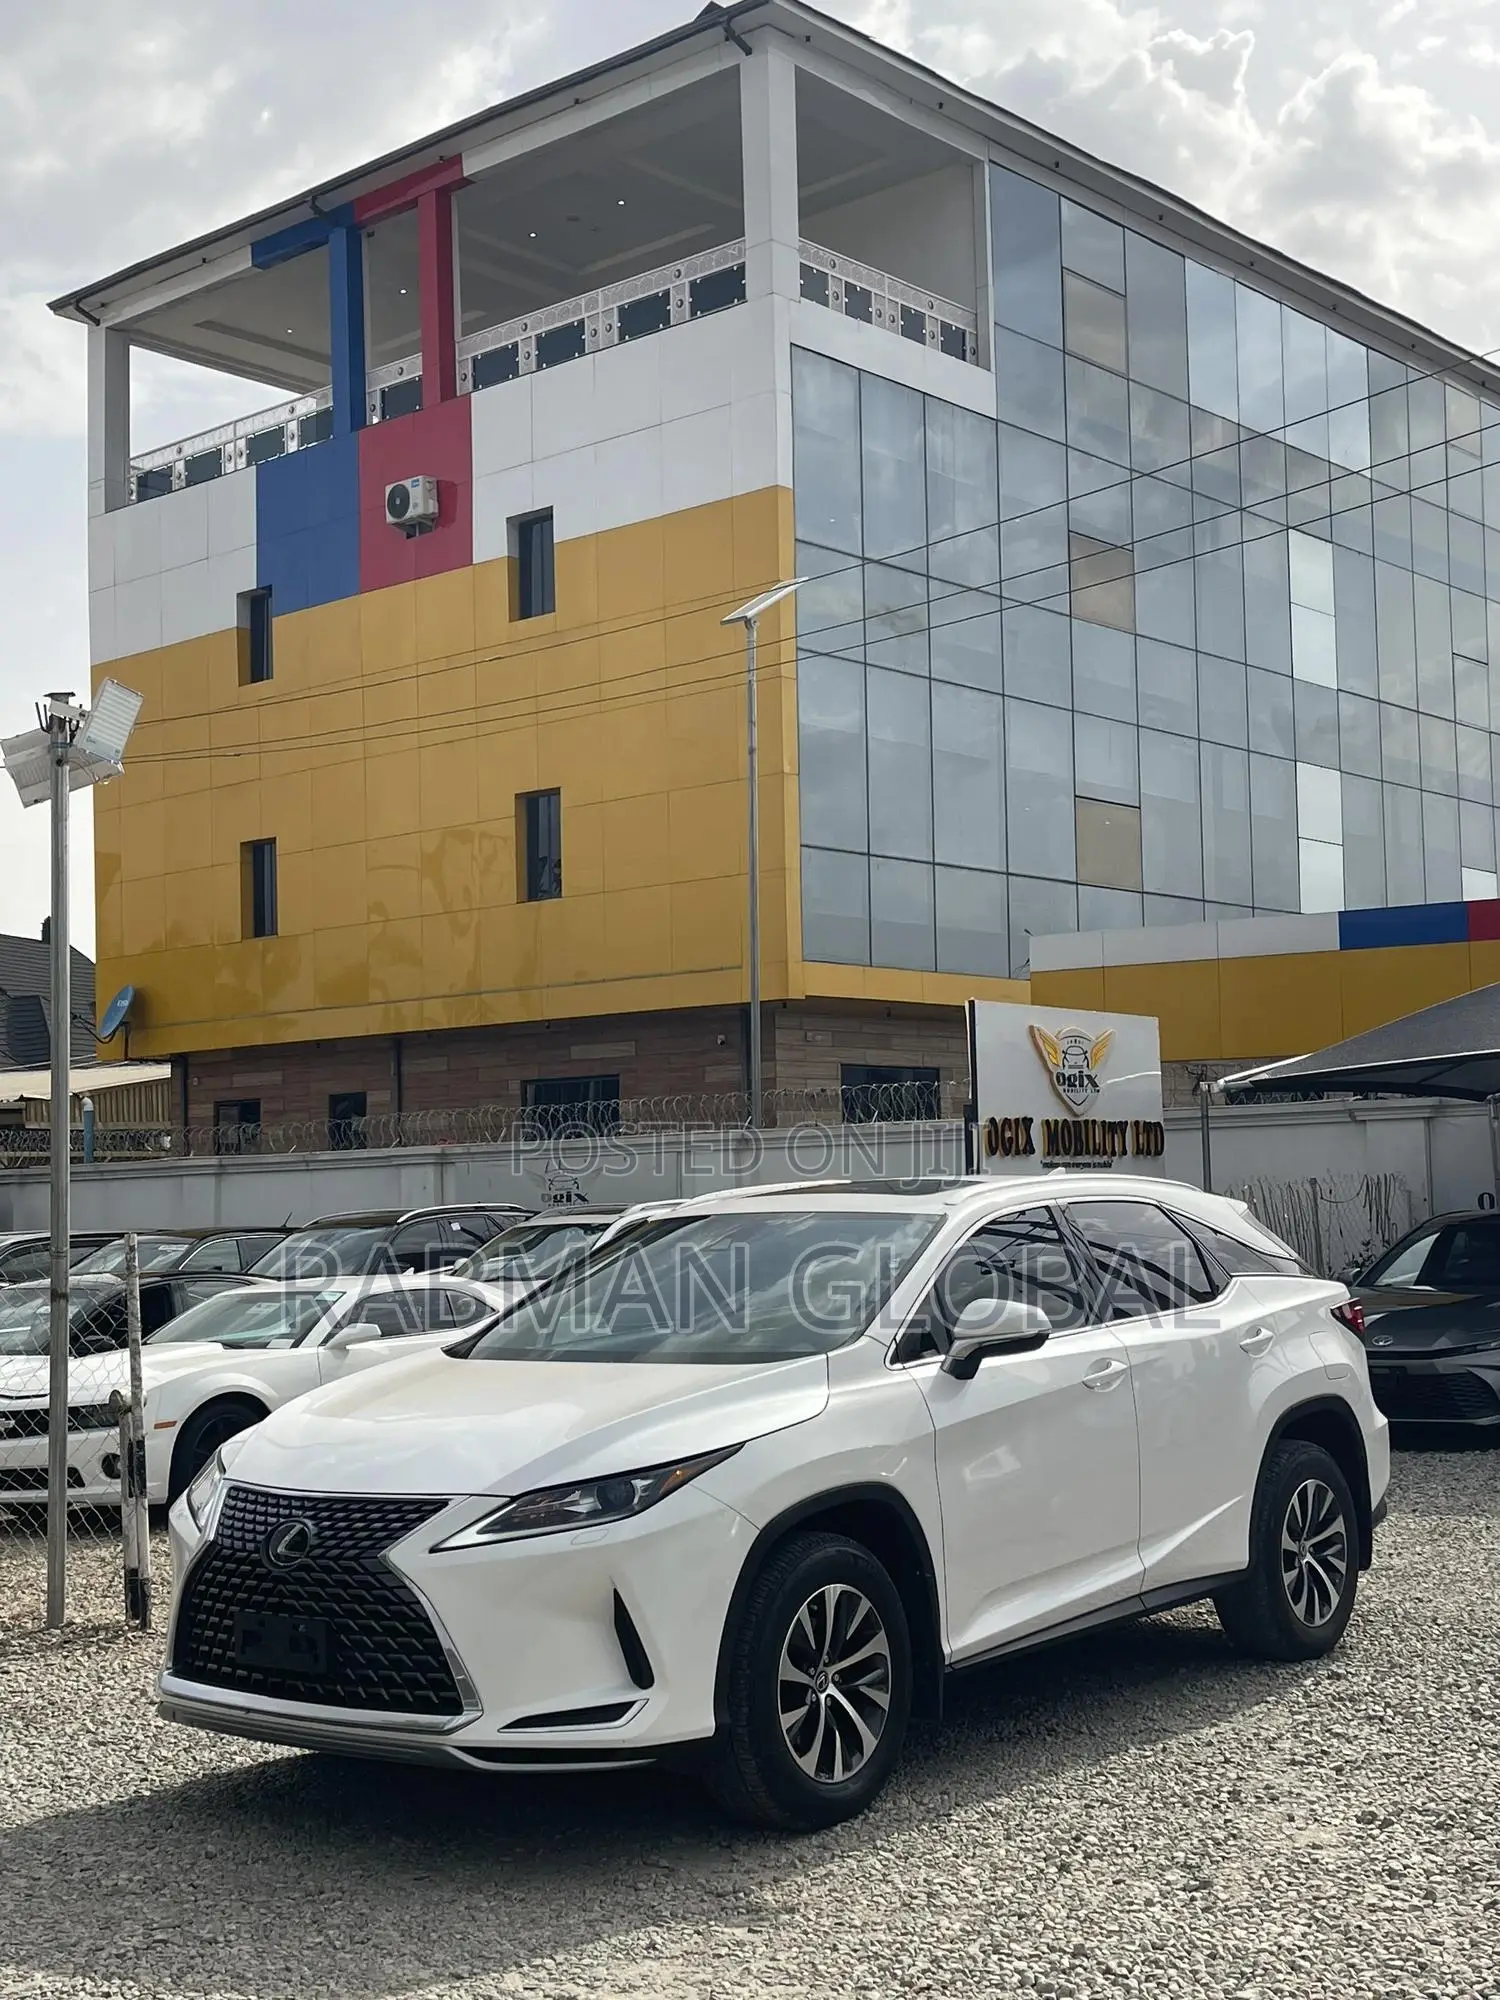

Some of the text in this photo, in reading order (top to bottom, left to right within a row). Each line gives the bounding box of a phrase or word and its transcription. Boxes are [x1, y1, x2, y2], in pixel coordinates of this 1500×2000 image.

[984, 1116, 1165, 1157] OGIX MOBILITY LTD
